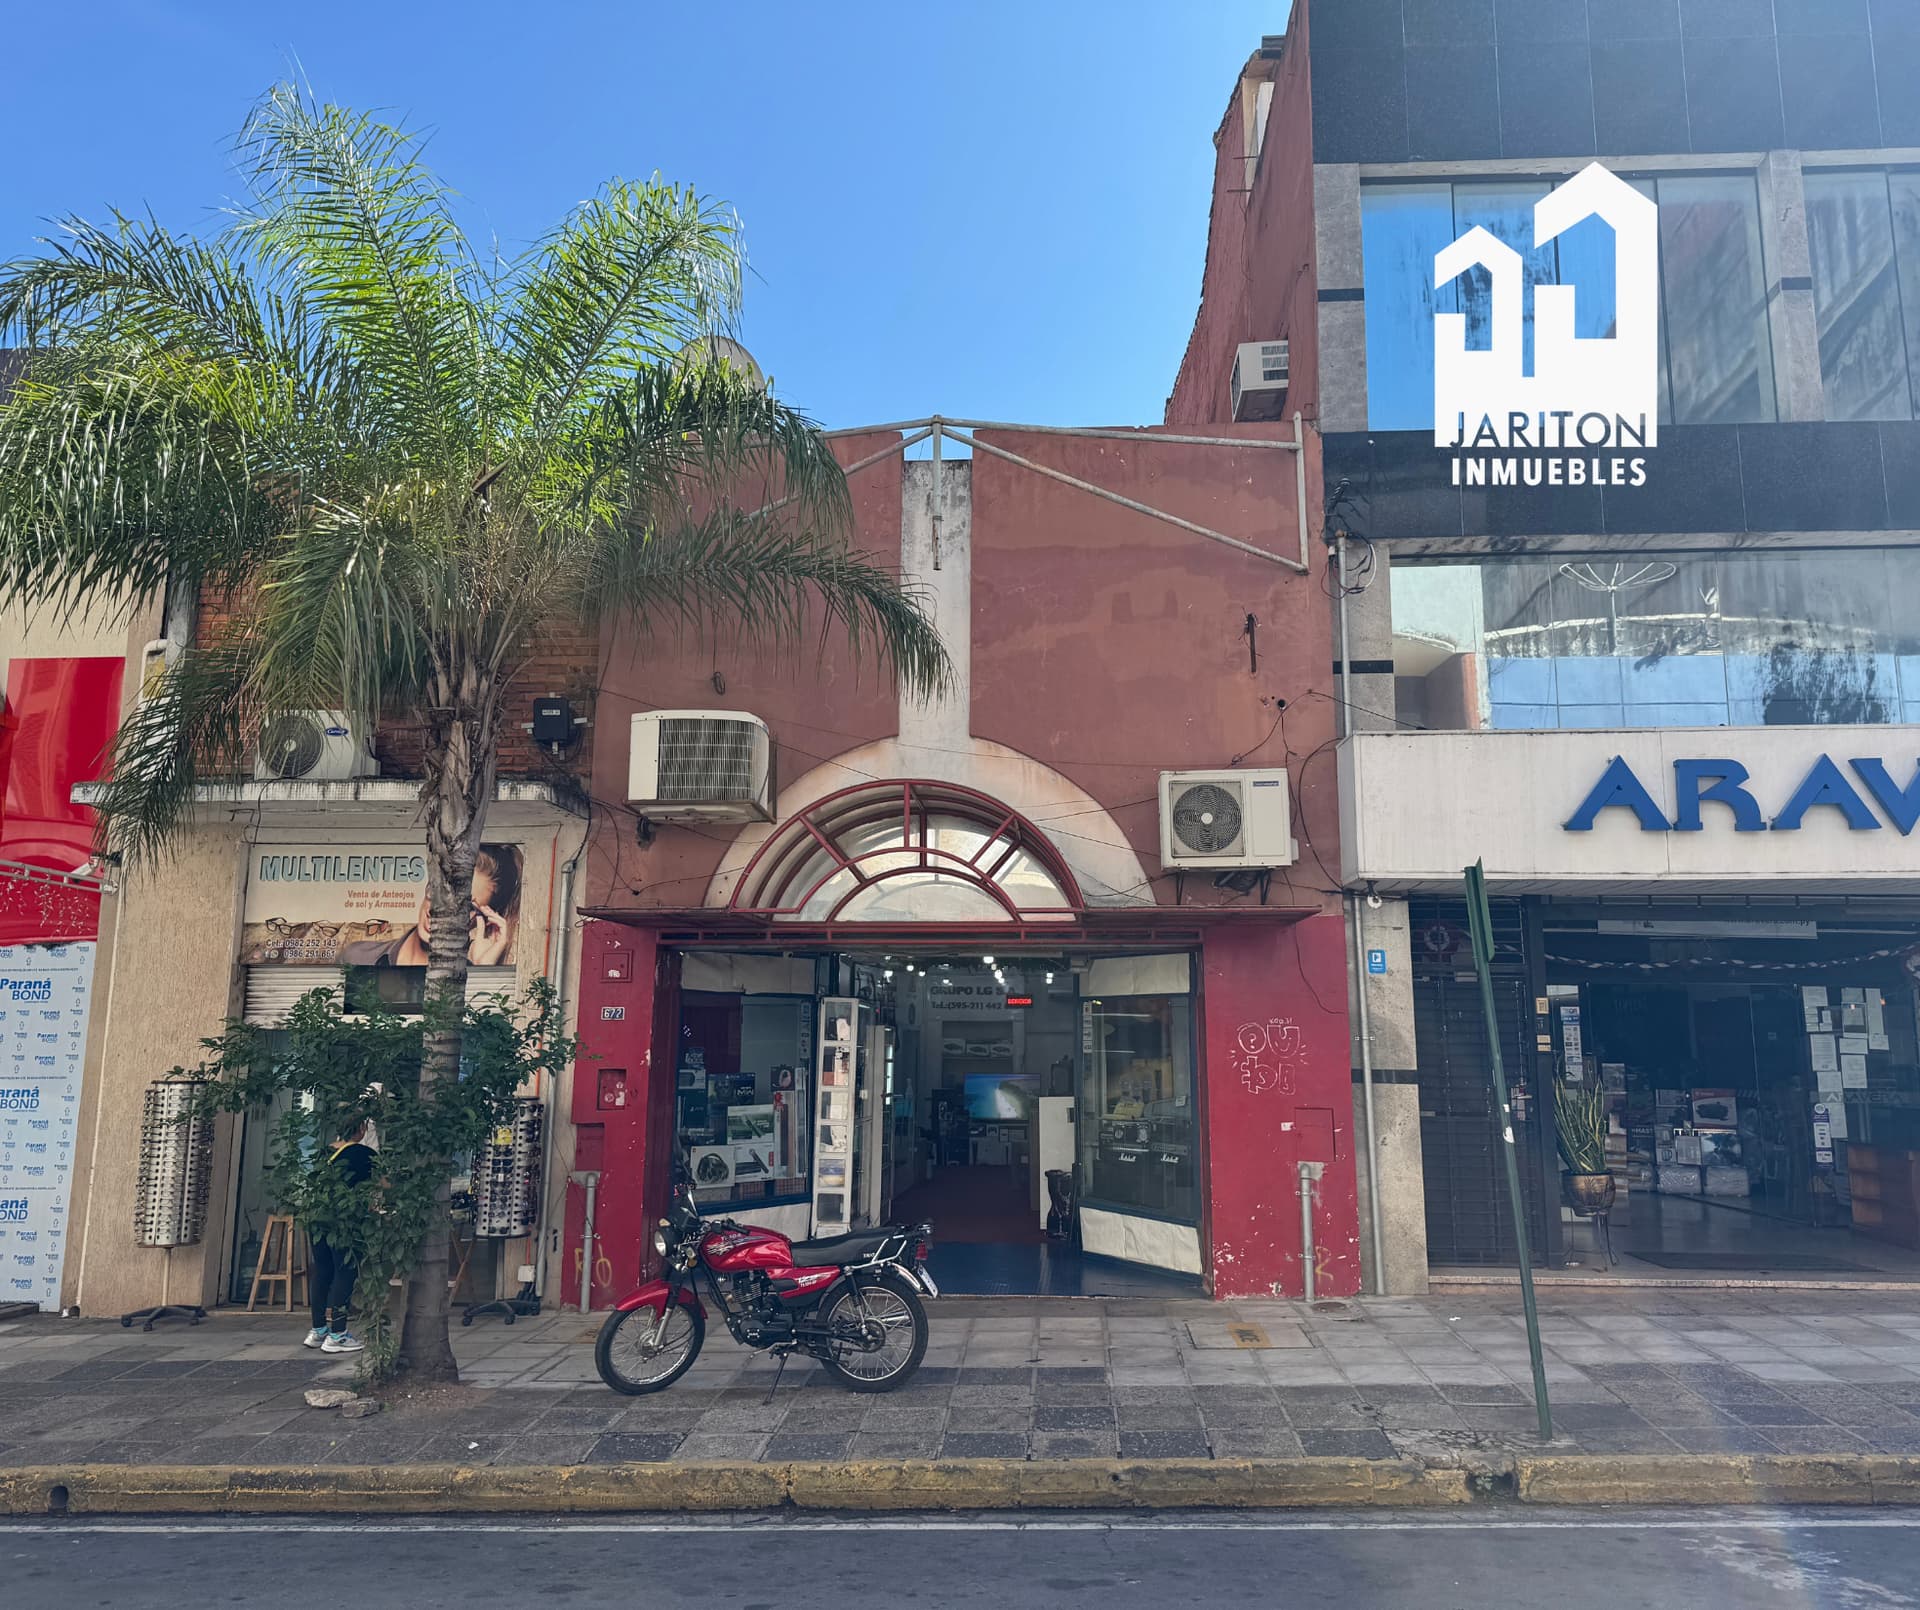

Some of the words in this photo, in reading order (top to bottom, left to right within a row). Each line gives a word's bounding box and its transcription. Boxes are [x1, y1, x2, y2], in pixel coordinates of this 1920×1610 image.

[1562, 753, 1920, 836] ARAV
[260, 856, 425, 882] MULTILENTES
[348, 890, 369, 898] Venta
[371, 890, 380, 898] de
[382, 890, 415, 900] Anteojos
[344, 900, 354, 908] de
[355, 900, 367, 908] sol
[375, 900, 416, 908] Armazones
[0, 977, 51, 990] Paraná
[12, 990, 51, 1000] BOND
[930, 986, 973, 995] GRUPO
[976, 986, 993, 995] LG
[0, 1098, 39, 1109] BOND
